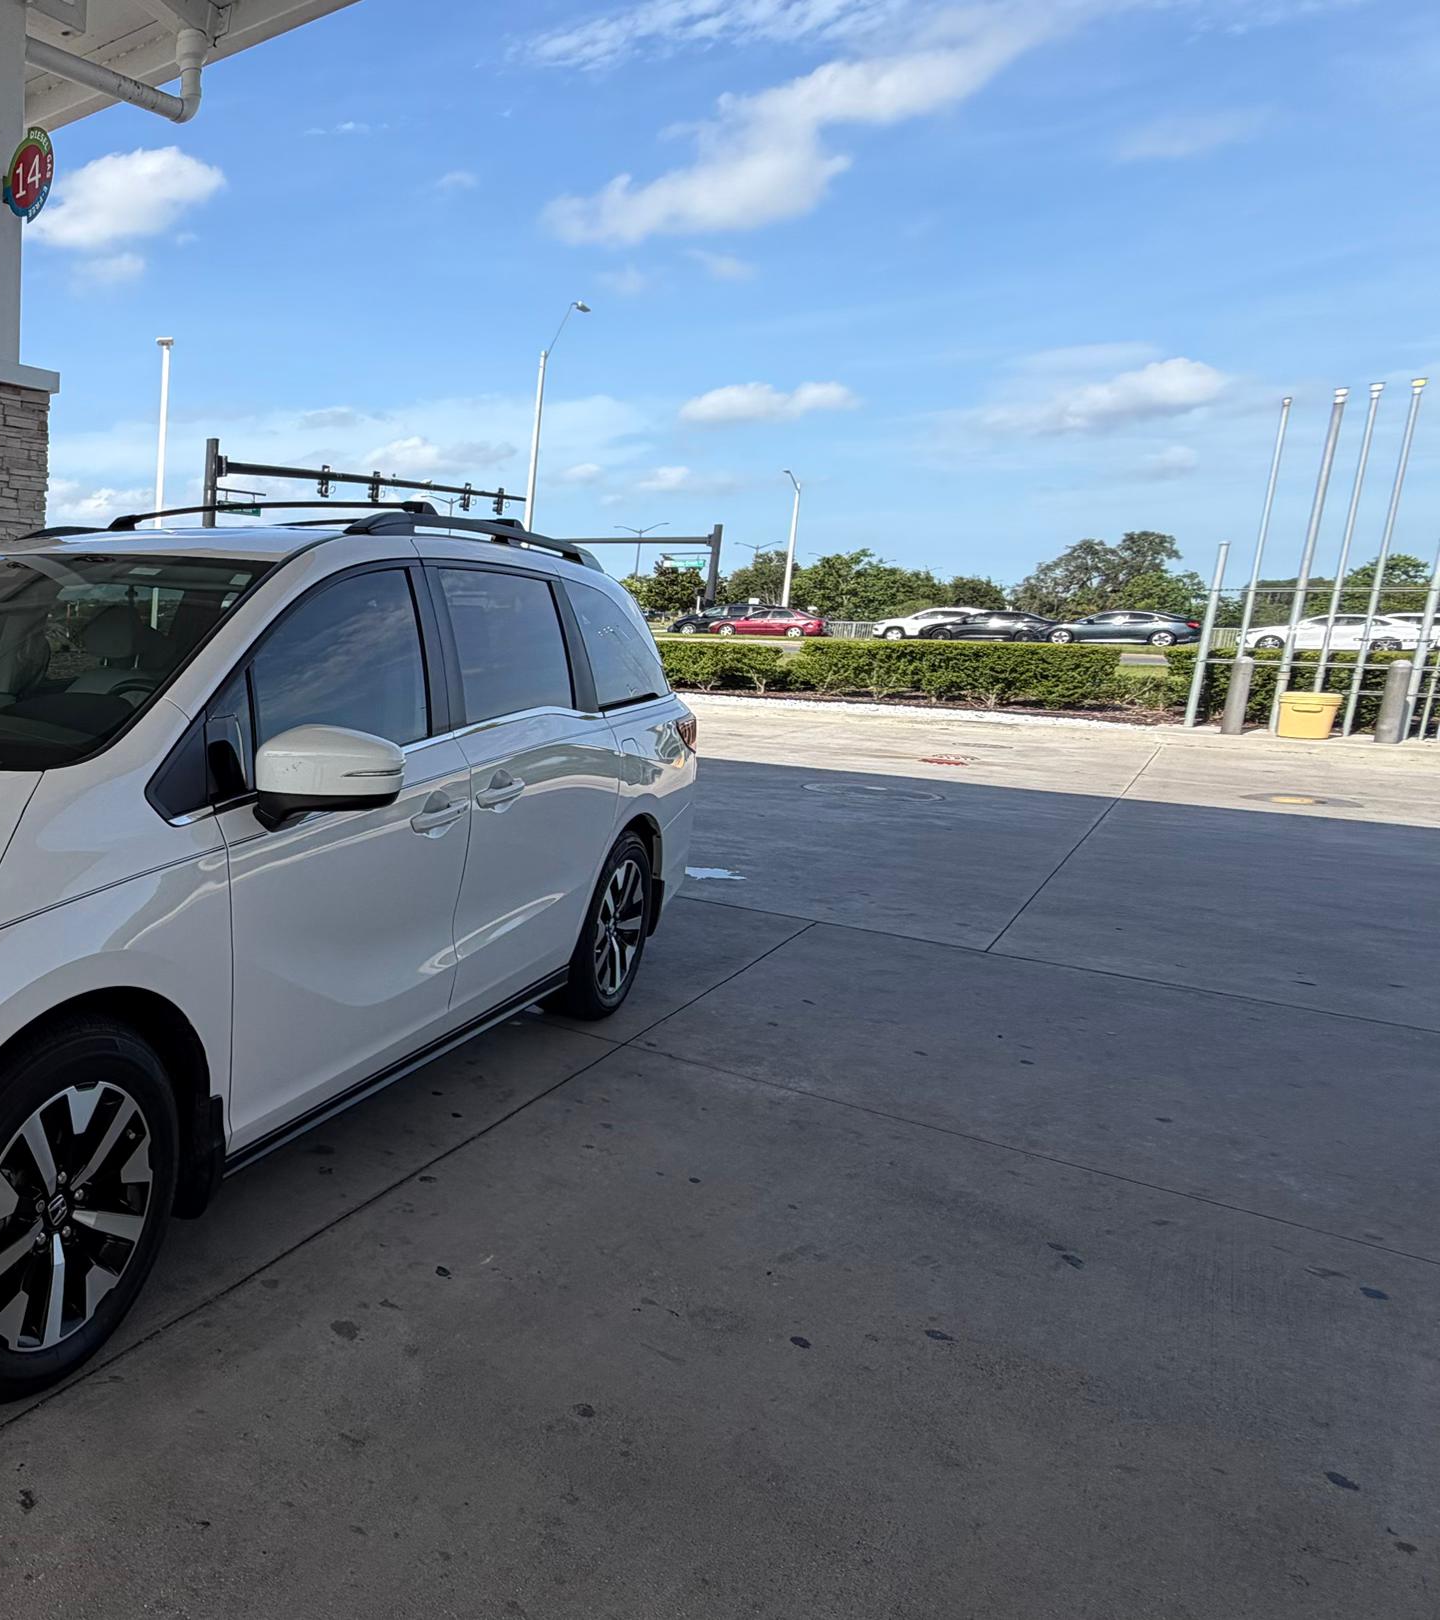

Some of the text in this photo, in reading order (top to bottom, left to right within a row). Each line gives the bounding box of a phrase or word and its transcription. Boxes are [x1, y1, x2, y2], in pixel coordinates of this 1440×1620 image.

[30, 130, 49, 150] DIESEL
[15, 153, 42, 198] 14
[28, 185, 48, 217] E-FREE
